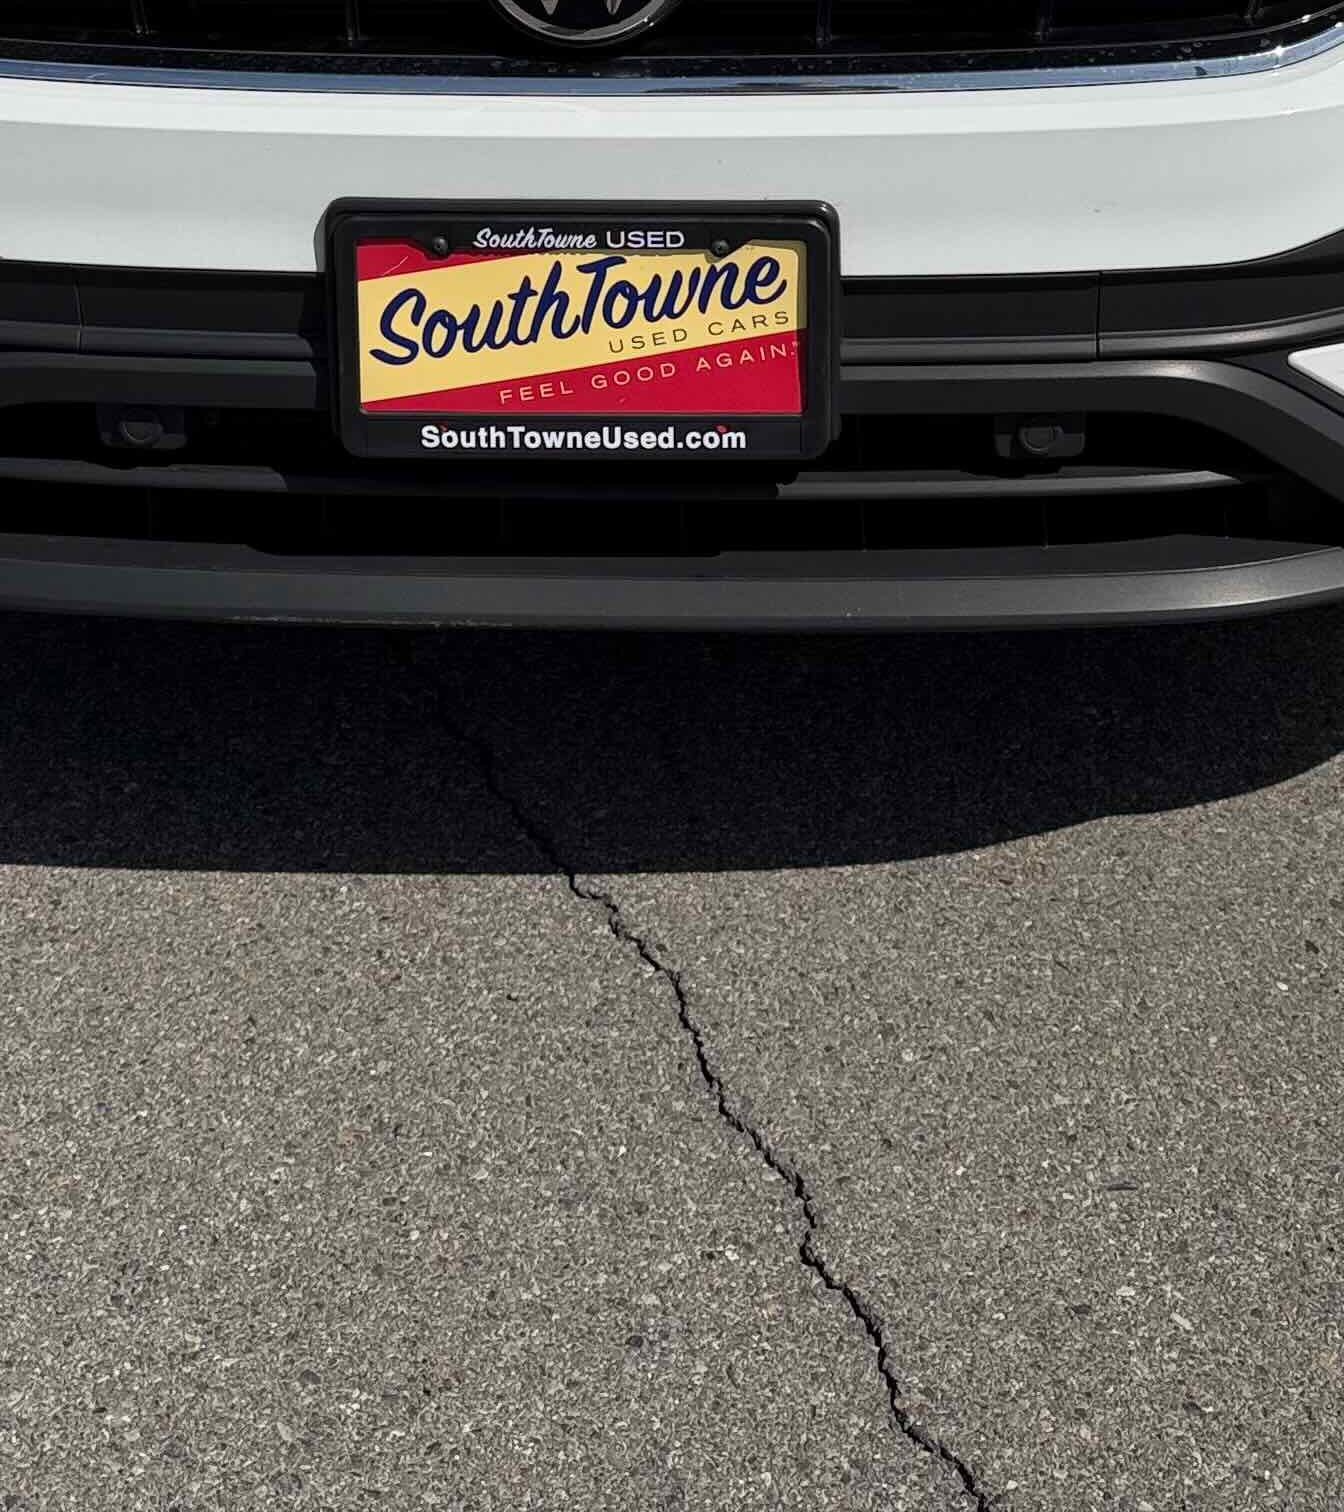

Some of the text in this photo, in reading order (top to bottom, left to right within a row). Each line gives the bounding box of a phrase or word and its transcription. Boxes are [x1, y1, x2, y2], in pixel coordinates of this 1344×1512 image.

[472, 227, 685, 249] SouthTowne USED
[368, 255, 788, 366] SouthTowne
[608, 311, 790, 354] USED CARS
[498, 380, 574, 405] FEEL
[590, 362, 676, 390] GOOD
[420, 424, 747, 449] SouthTowneUsed.com
